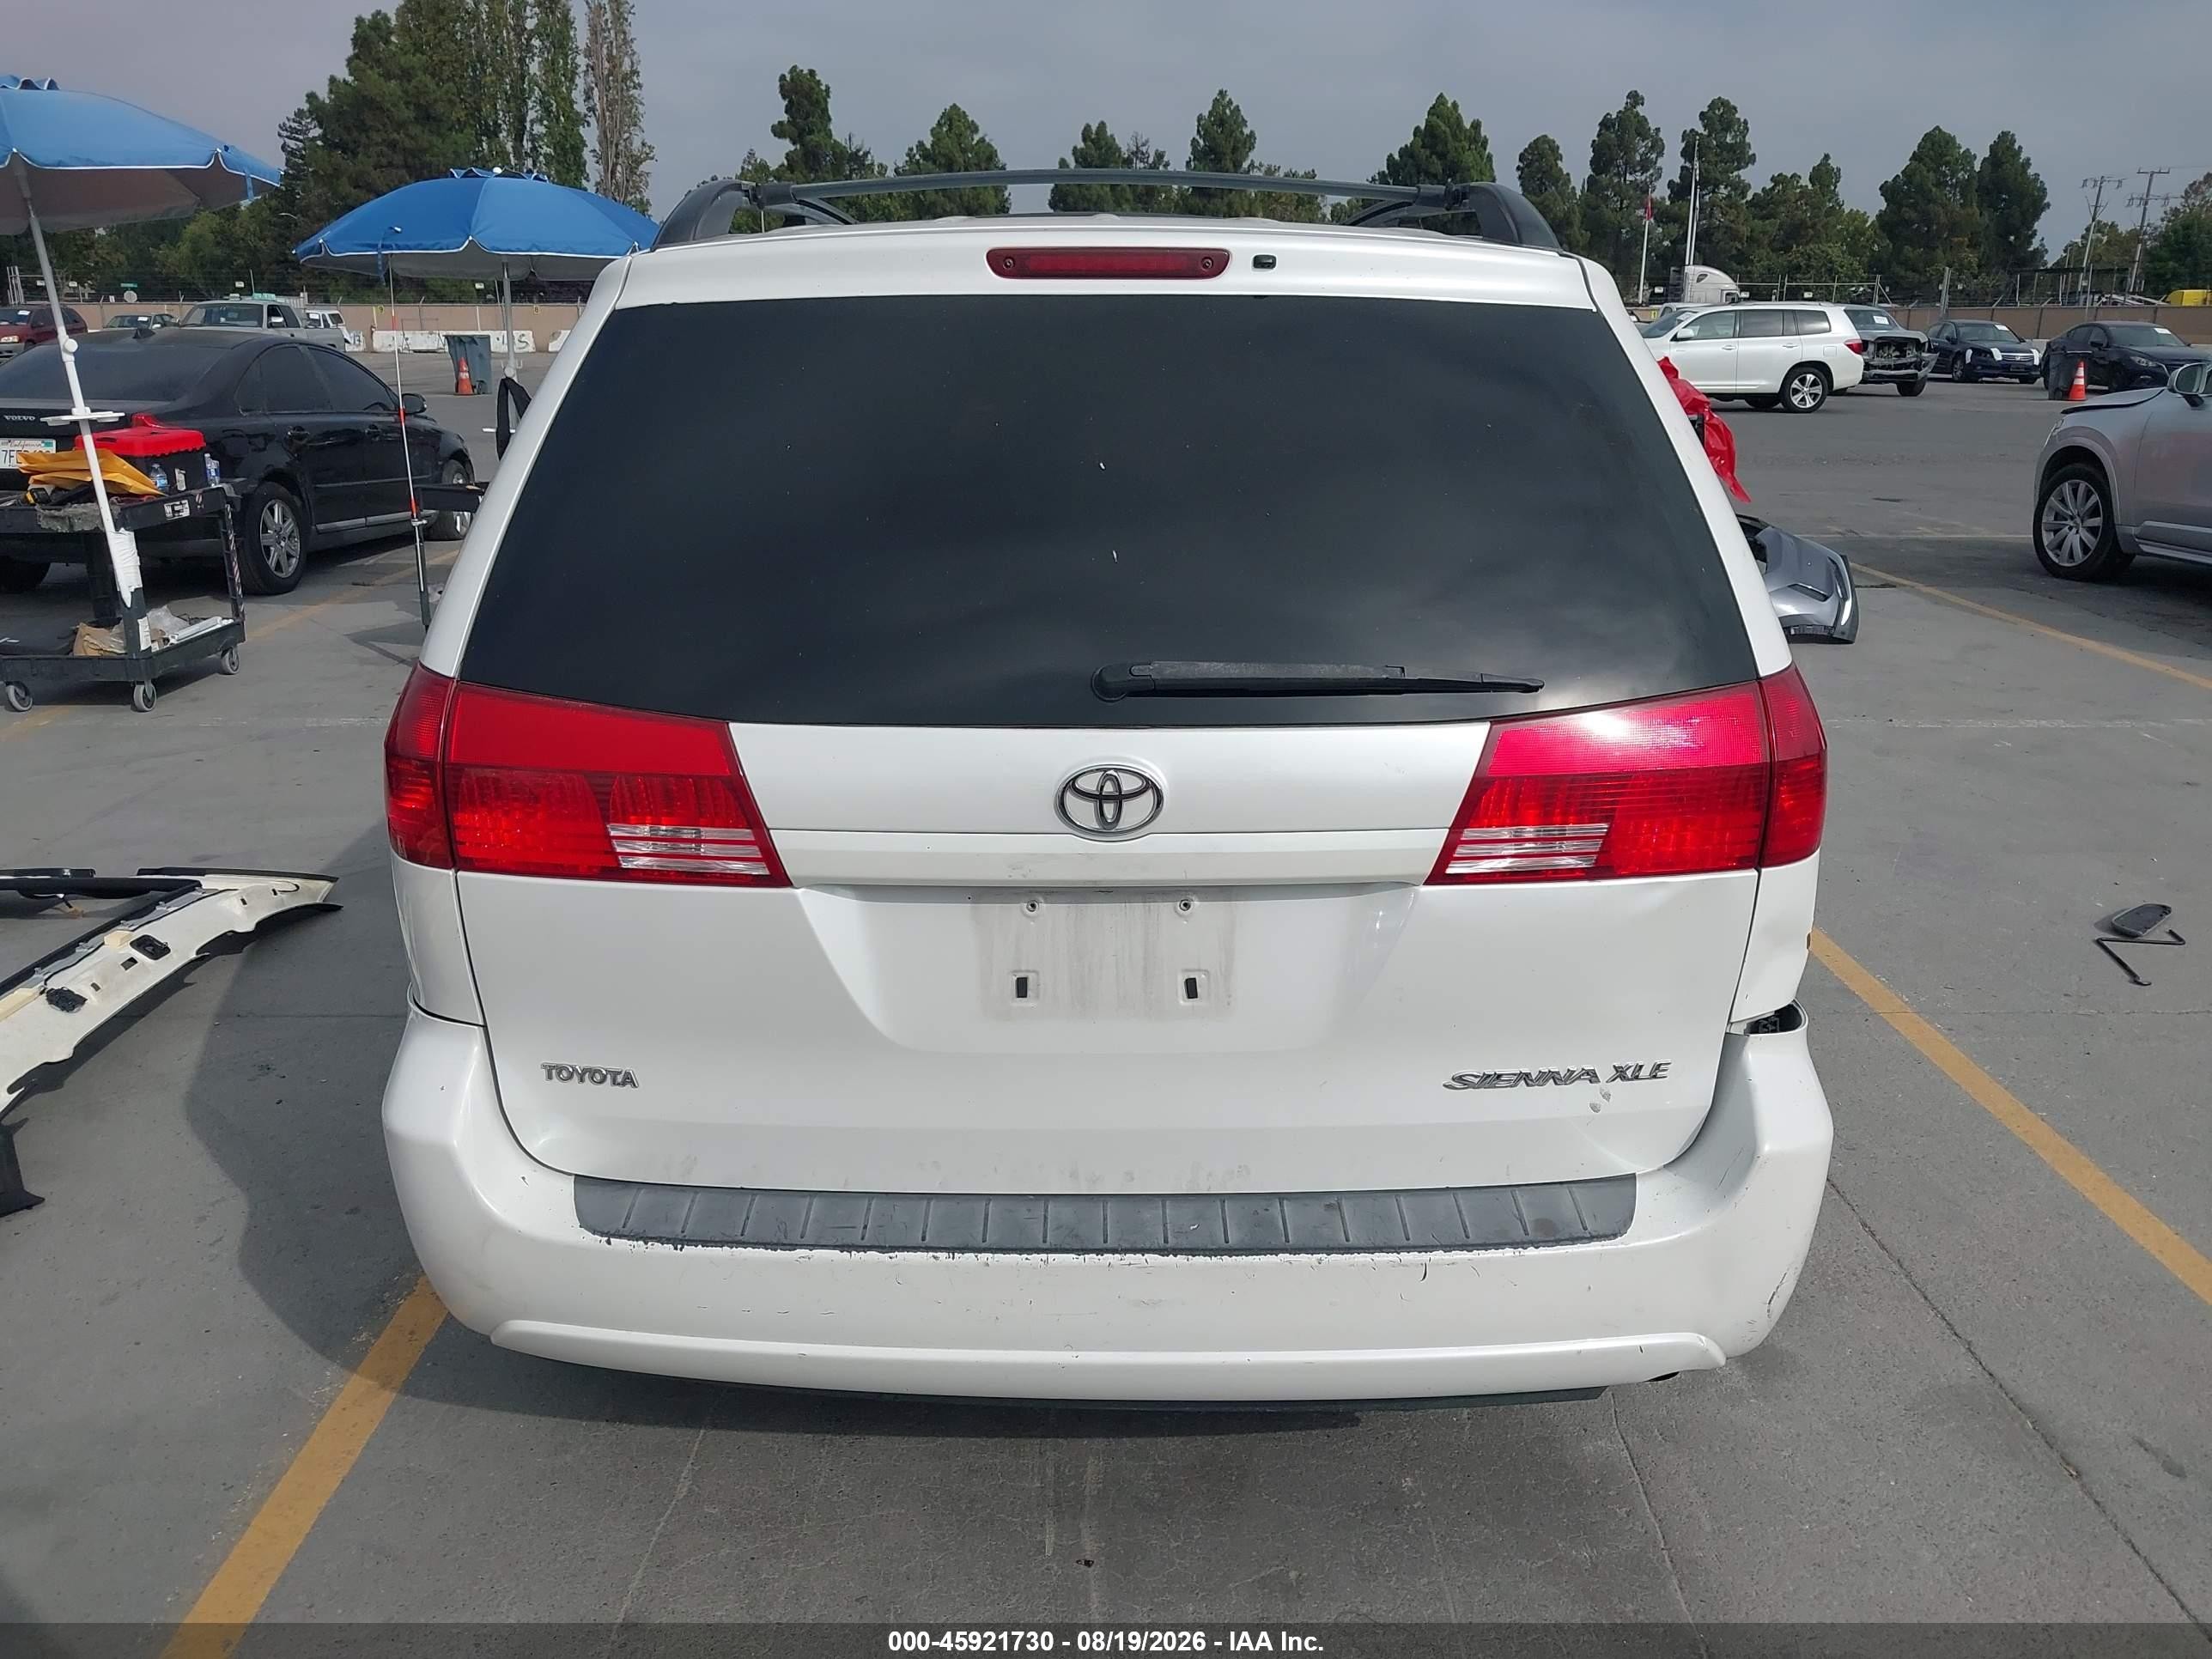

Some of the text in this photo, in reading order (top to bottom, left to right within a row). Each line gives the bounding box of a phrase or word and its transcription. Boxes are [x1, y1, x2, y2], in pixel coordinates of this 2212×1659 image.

[9, 440, 41, 449] California
[541, 1062, 639, 1088] TOYOTA
[1443, 1059, 1672, 1091] SIENNA XLE
